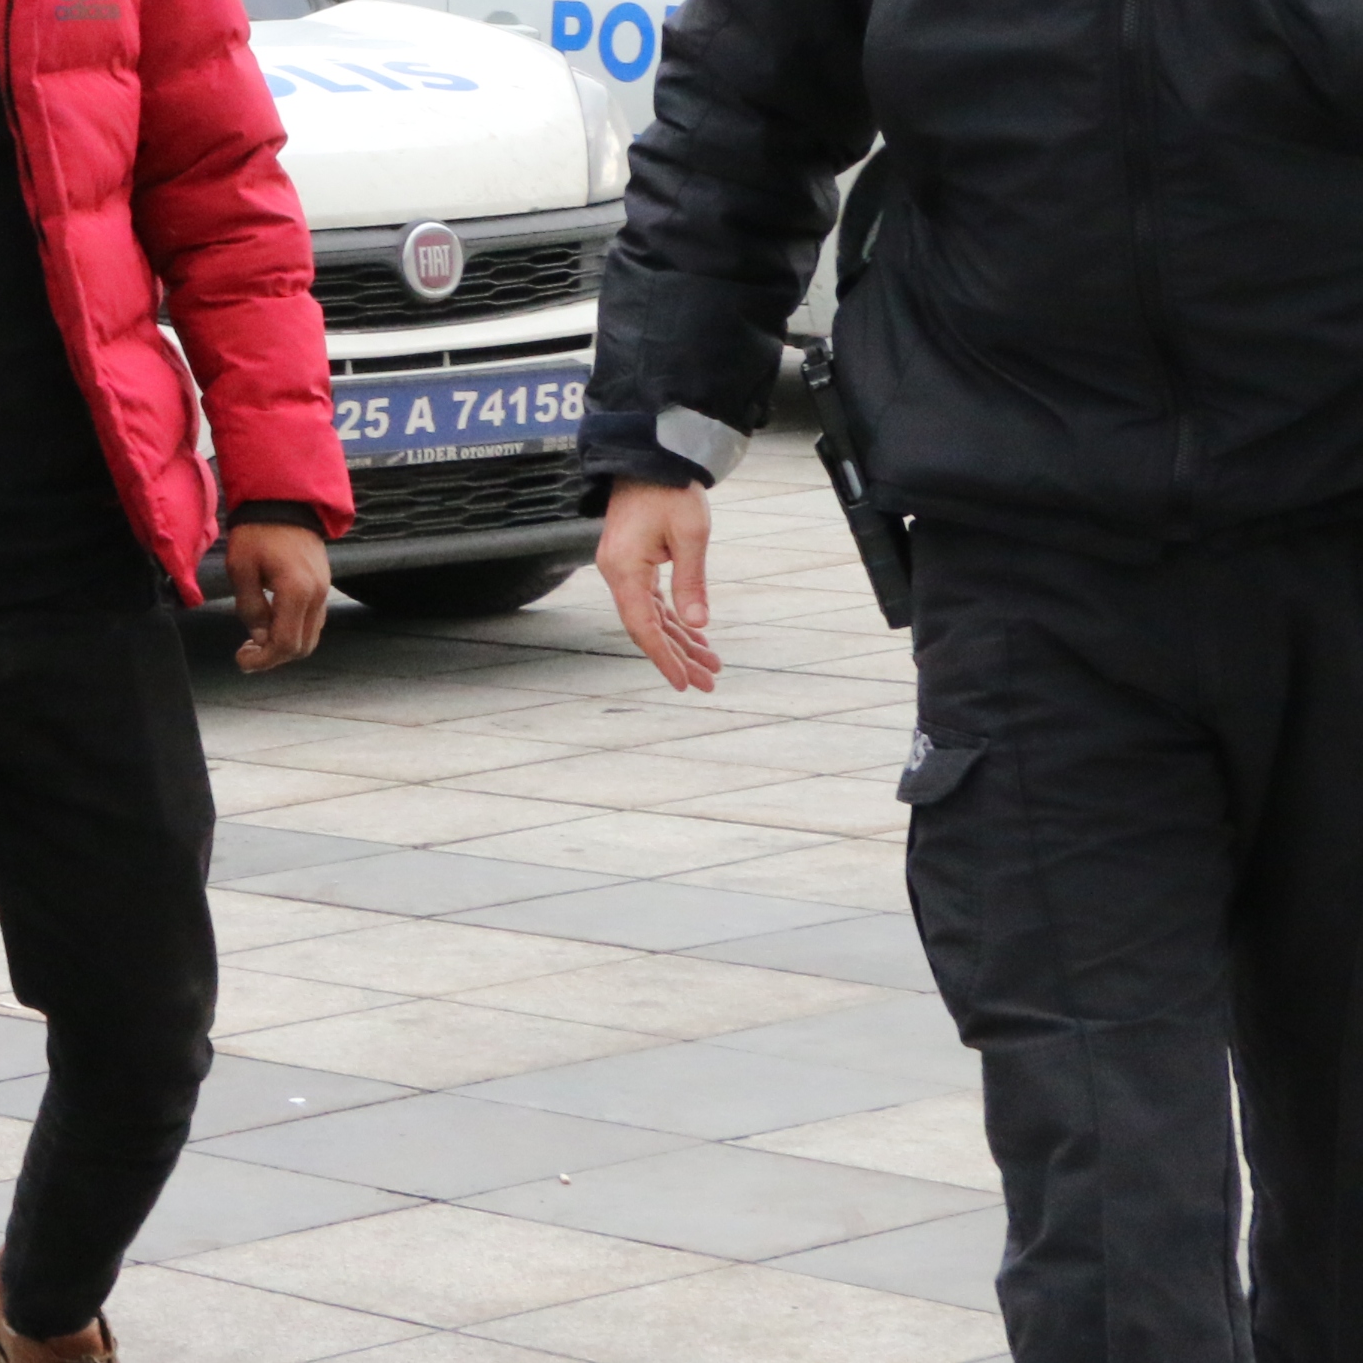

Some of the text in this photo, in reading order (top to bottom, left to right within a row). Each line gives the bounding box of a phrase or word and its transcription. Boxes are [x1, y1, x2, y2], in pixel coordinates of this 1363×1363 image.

[551, 0, 680, 82] PO
[418, 244, 451, 278] FIAT
[336, 381, 585, 441] 25 A 74158
